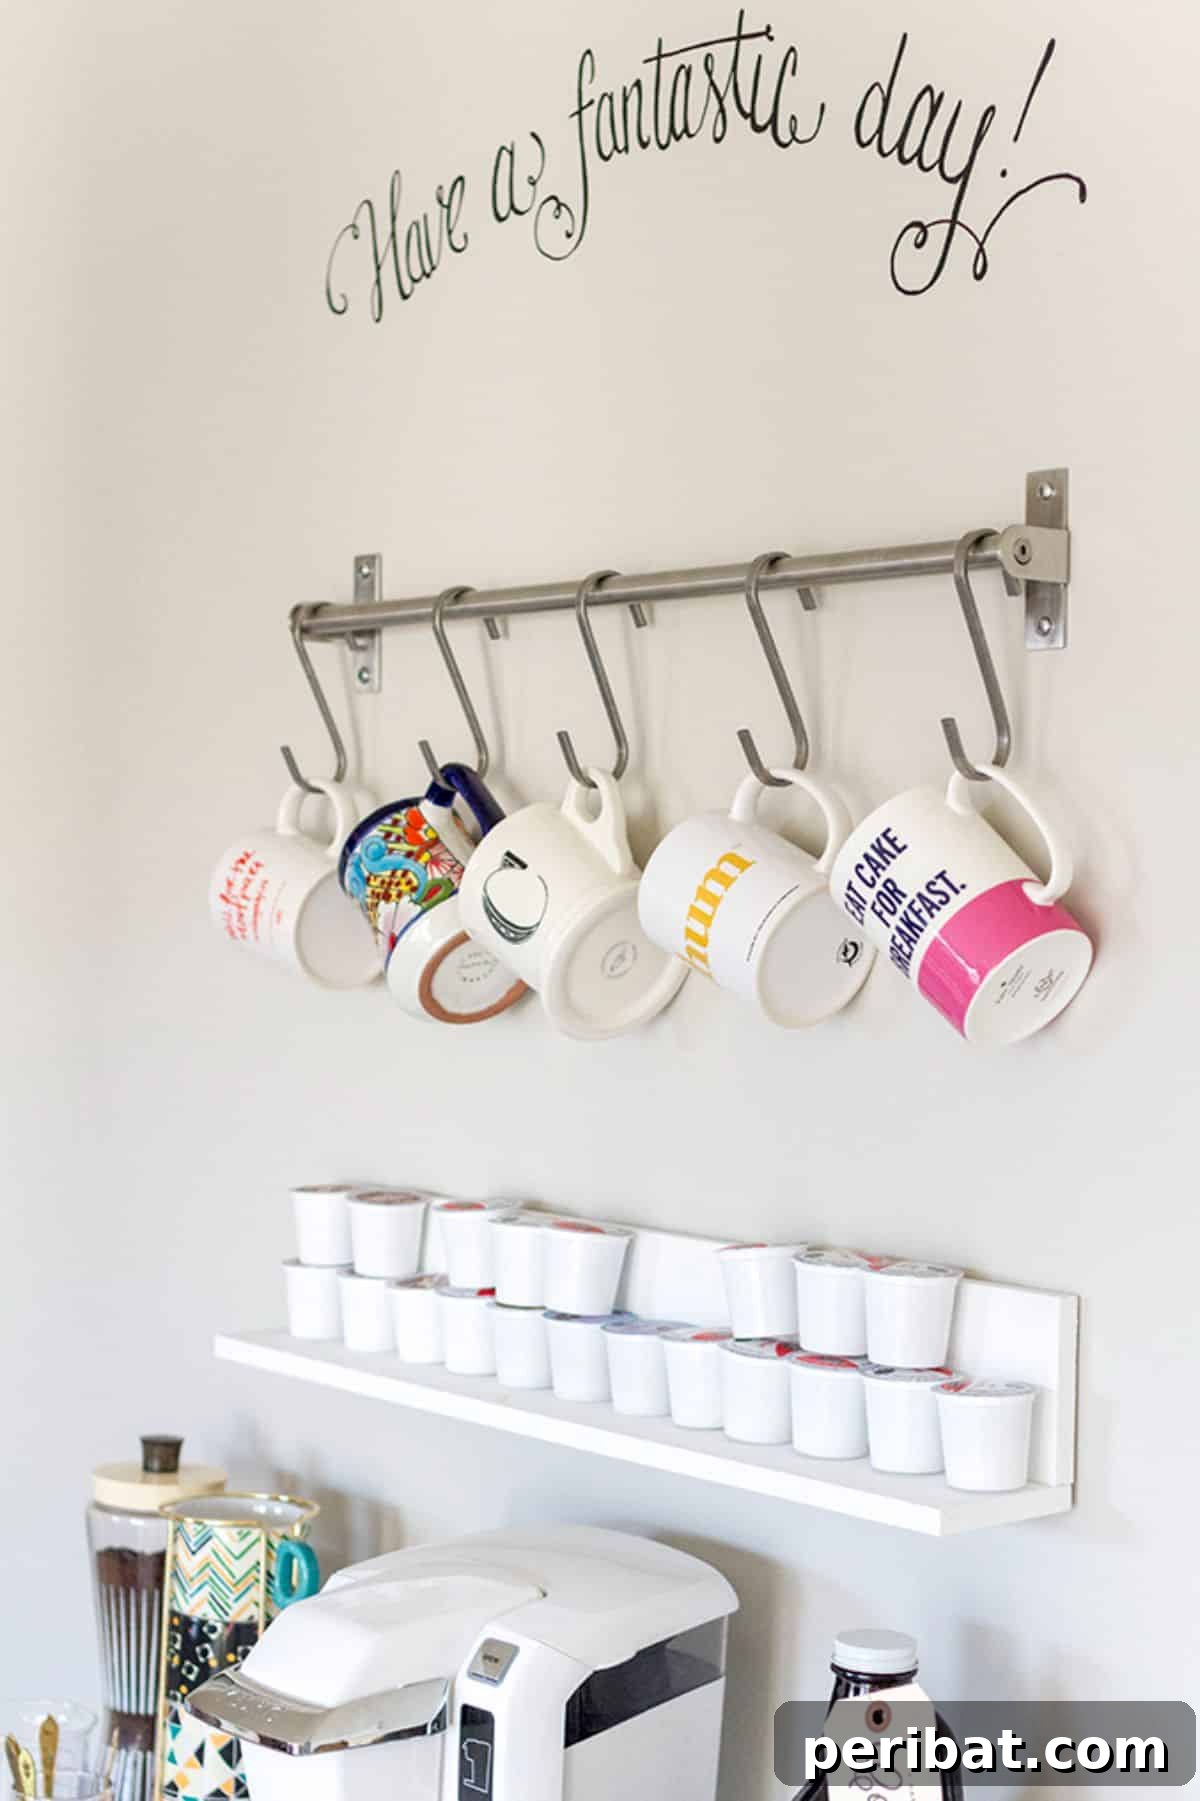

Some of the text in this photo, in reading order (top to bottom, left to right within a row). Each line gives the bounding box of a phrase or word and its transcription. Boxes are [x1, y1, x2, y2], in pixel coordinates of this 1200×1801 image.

[325, 8, 1087, 323] Have a fantastic day!
[854, 826, 908, 889] CAKE
[844, 879, 868, 927] EAT
[870, 877, 907, 928] FOR
